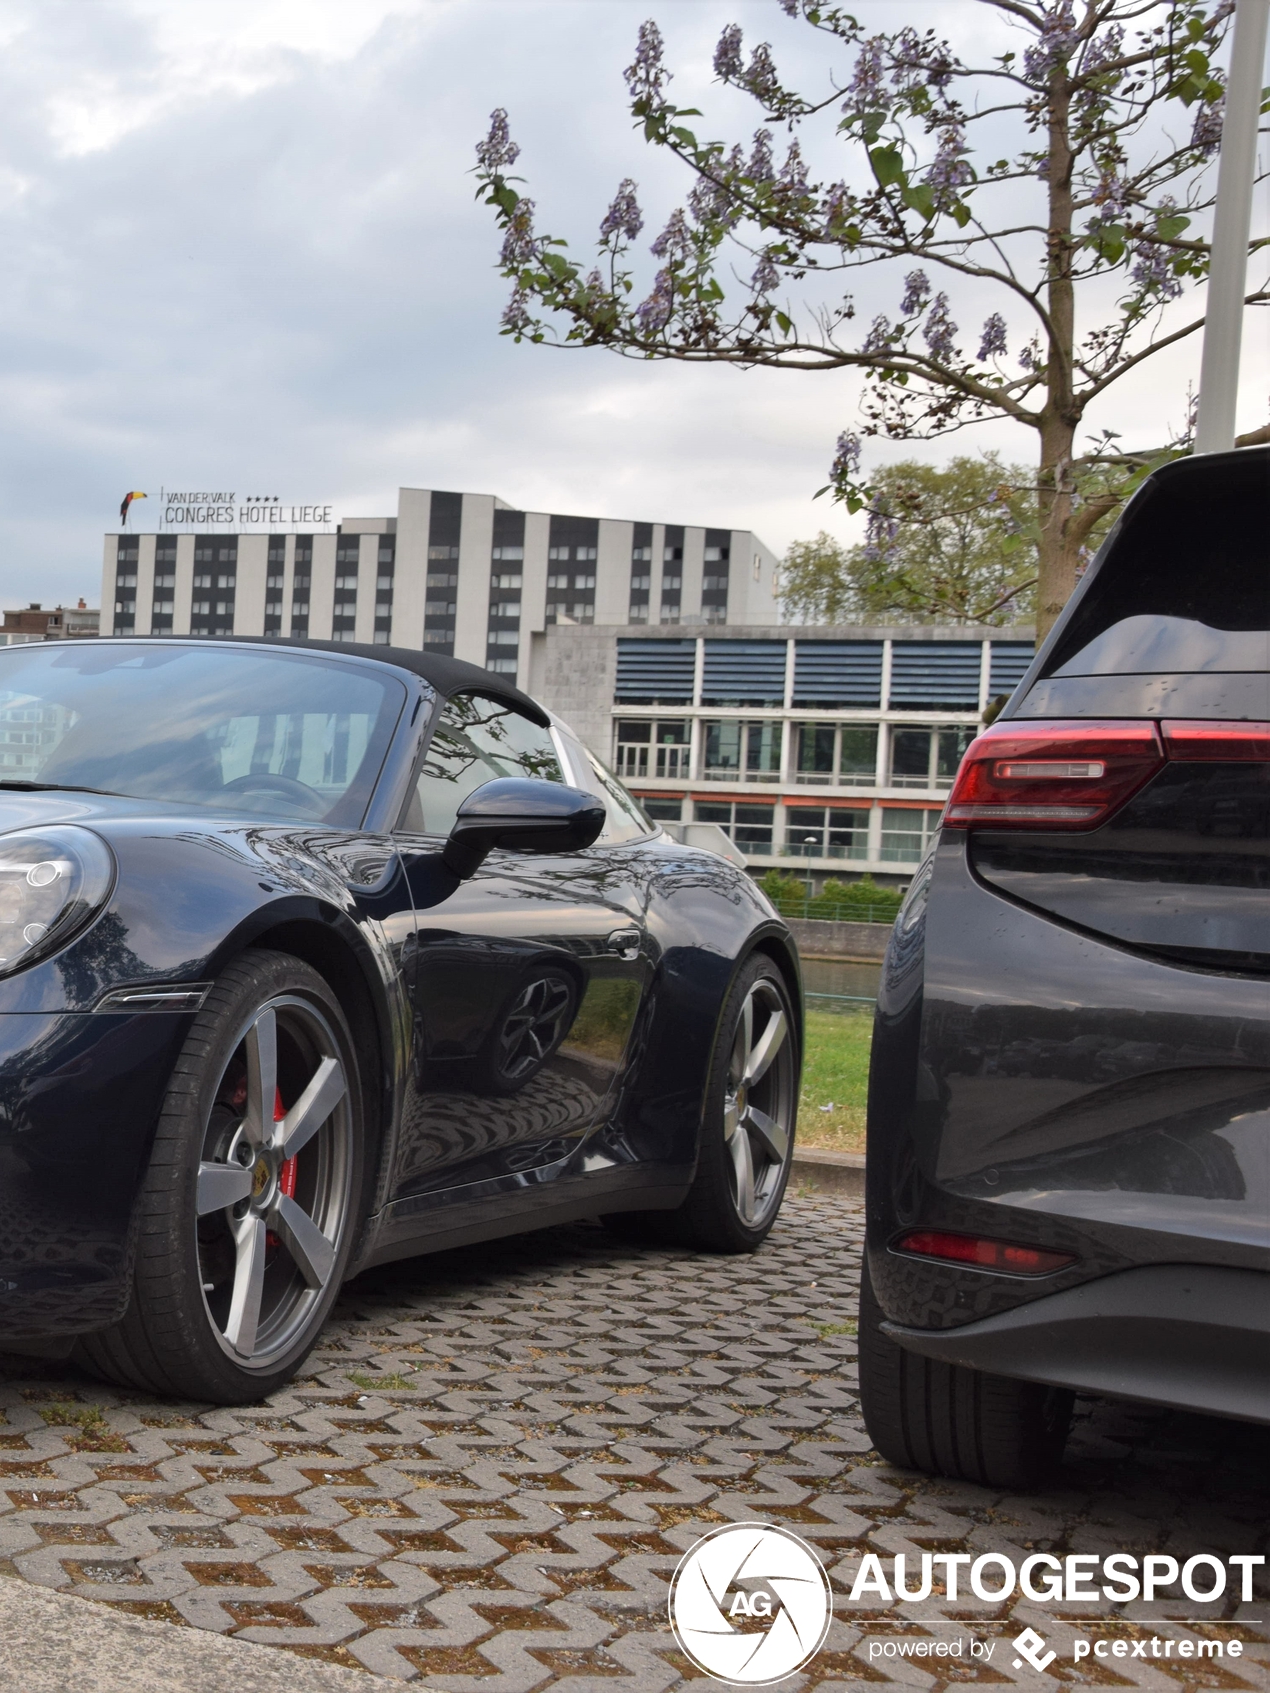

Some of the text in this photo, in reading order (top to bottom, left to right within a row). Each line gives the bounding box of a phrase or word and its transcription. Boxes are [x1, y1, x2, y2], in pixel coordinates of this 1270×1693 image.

[167, 492, 236, 504] VAN DER VALK
[165, 506, 332, 523] CONGRES HOTEL LIEGE
